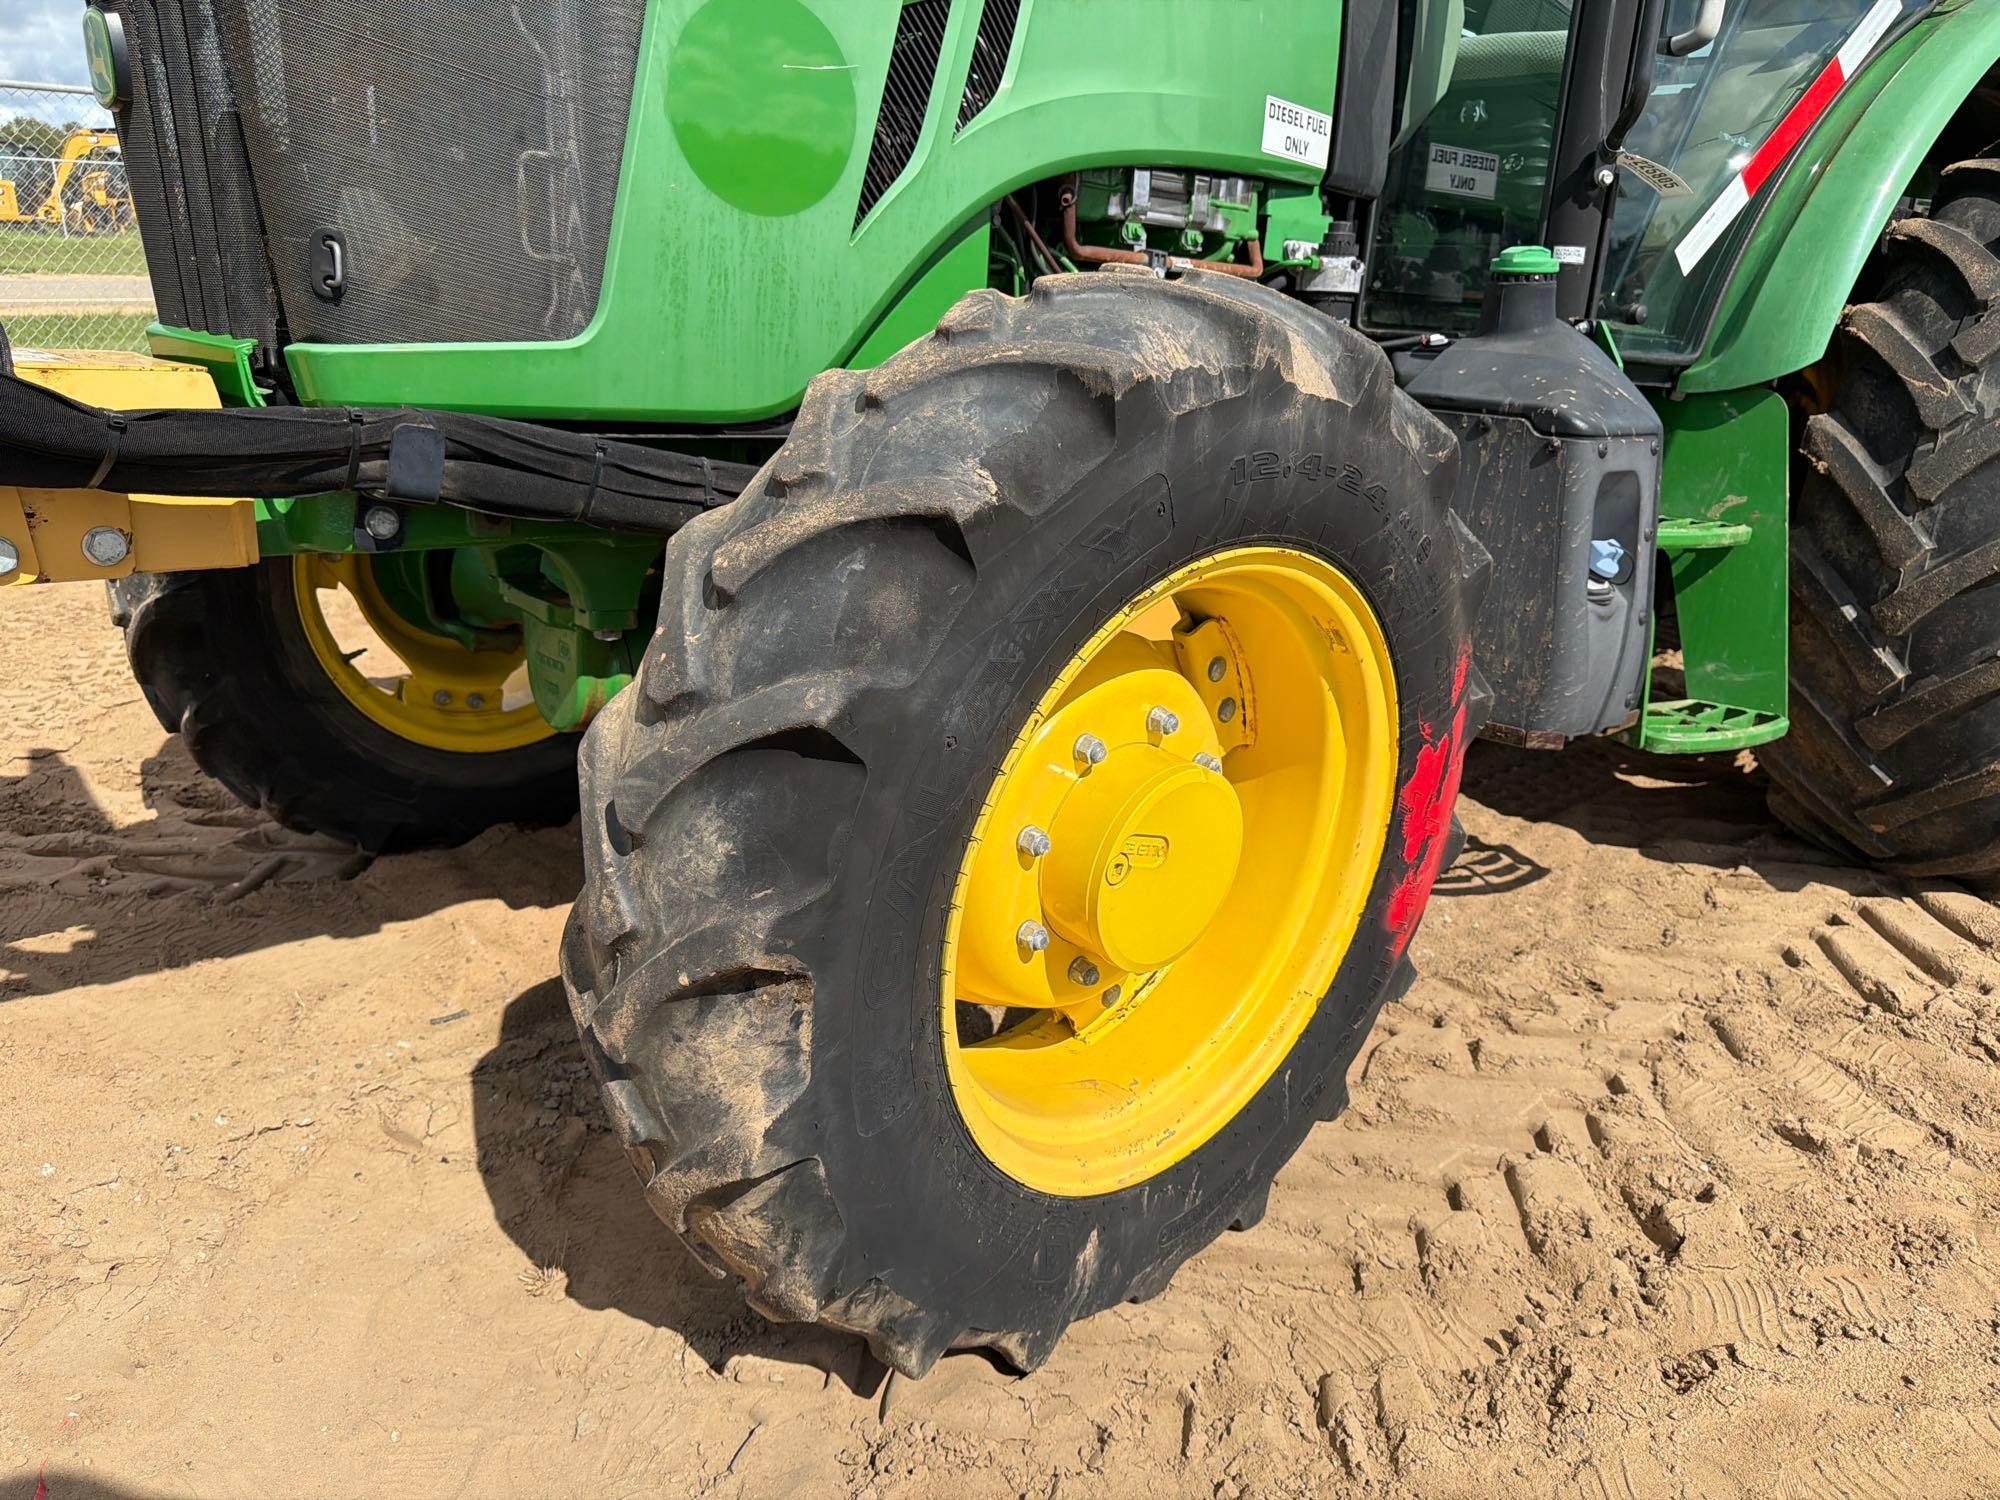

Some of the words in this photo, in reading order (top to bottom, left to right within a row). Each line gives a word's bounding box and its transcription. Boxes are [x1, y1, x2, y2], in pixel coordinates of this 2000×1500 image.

[1268, 102, 1304, 129] DIESEL
[1306, 114, 1328, 137] FUEL
[1284, 135, 1310, 157] ONLY
[1230, 451, 1388, 513] 12.4-24
